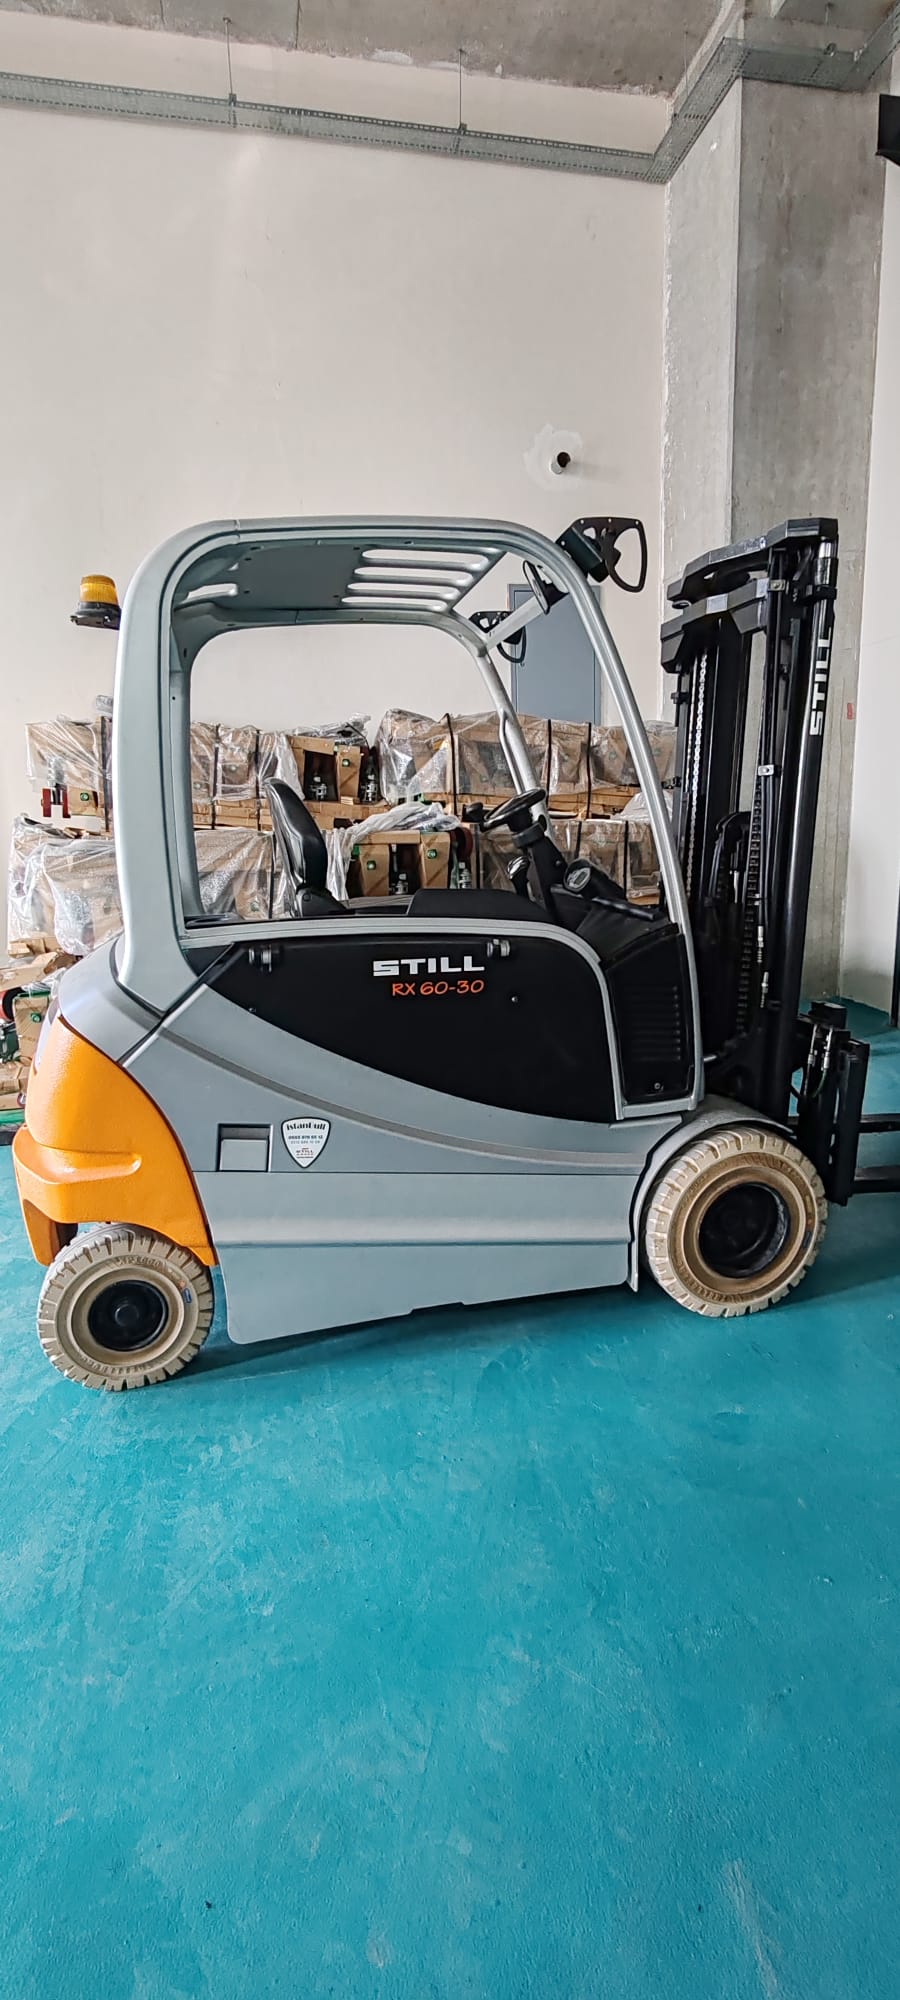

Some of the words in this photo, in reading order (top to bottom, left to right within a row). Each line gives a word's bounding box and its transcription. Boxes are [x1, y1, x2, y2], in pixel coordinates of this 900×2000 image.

[809, 626, 832, 736] STILL
[373, 956, 485, 976] STILL
[392, 982, 416, 996] RX
[420, 980, 484, 995] 60-30
